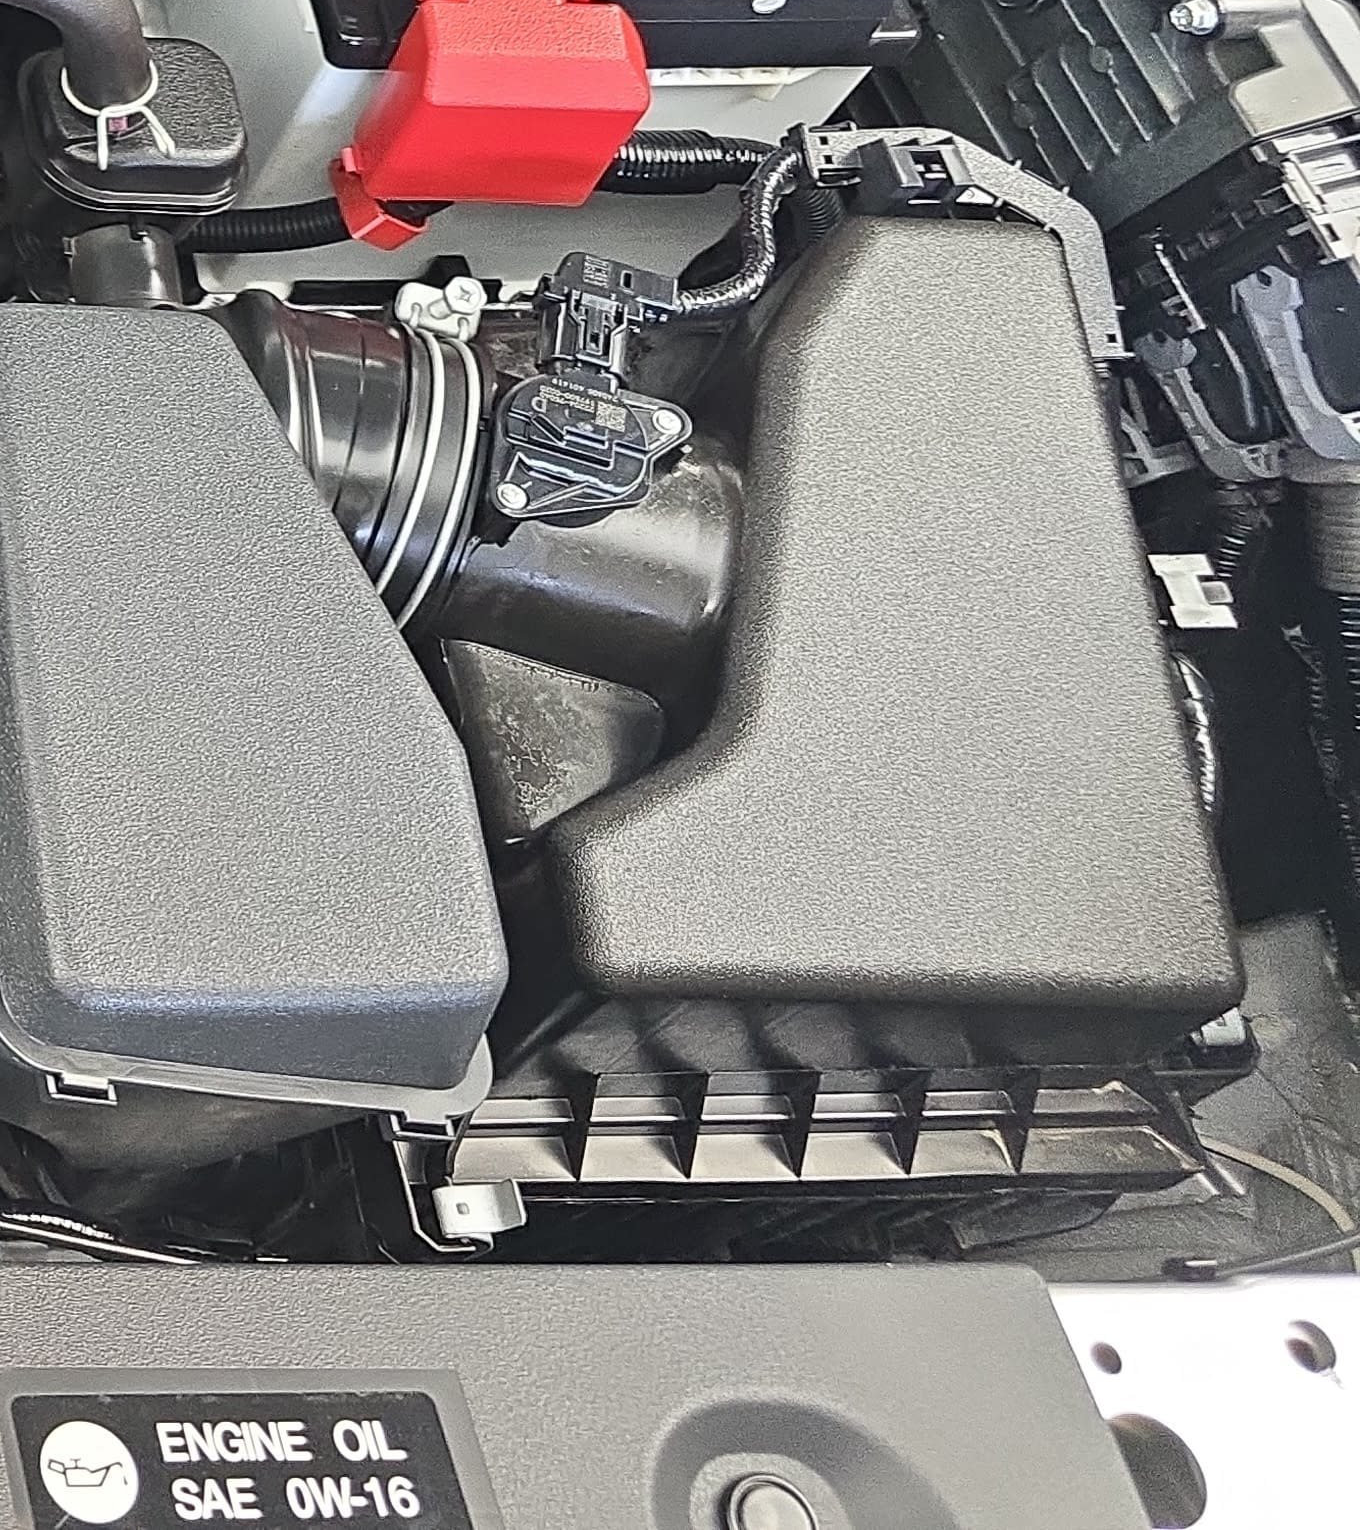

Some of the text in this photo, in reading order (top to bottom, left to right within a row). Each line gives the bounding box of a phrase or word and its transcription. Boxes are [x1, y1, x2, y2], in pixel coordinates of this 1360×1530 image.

[155, 1419, 408, 1463] ENGINE OIL
[171, 1476, 420, 1521] SAE 0W-16
